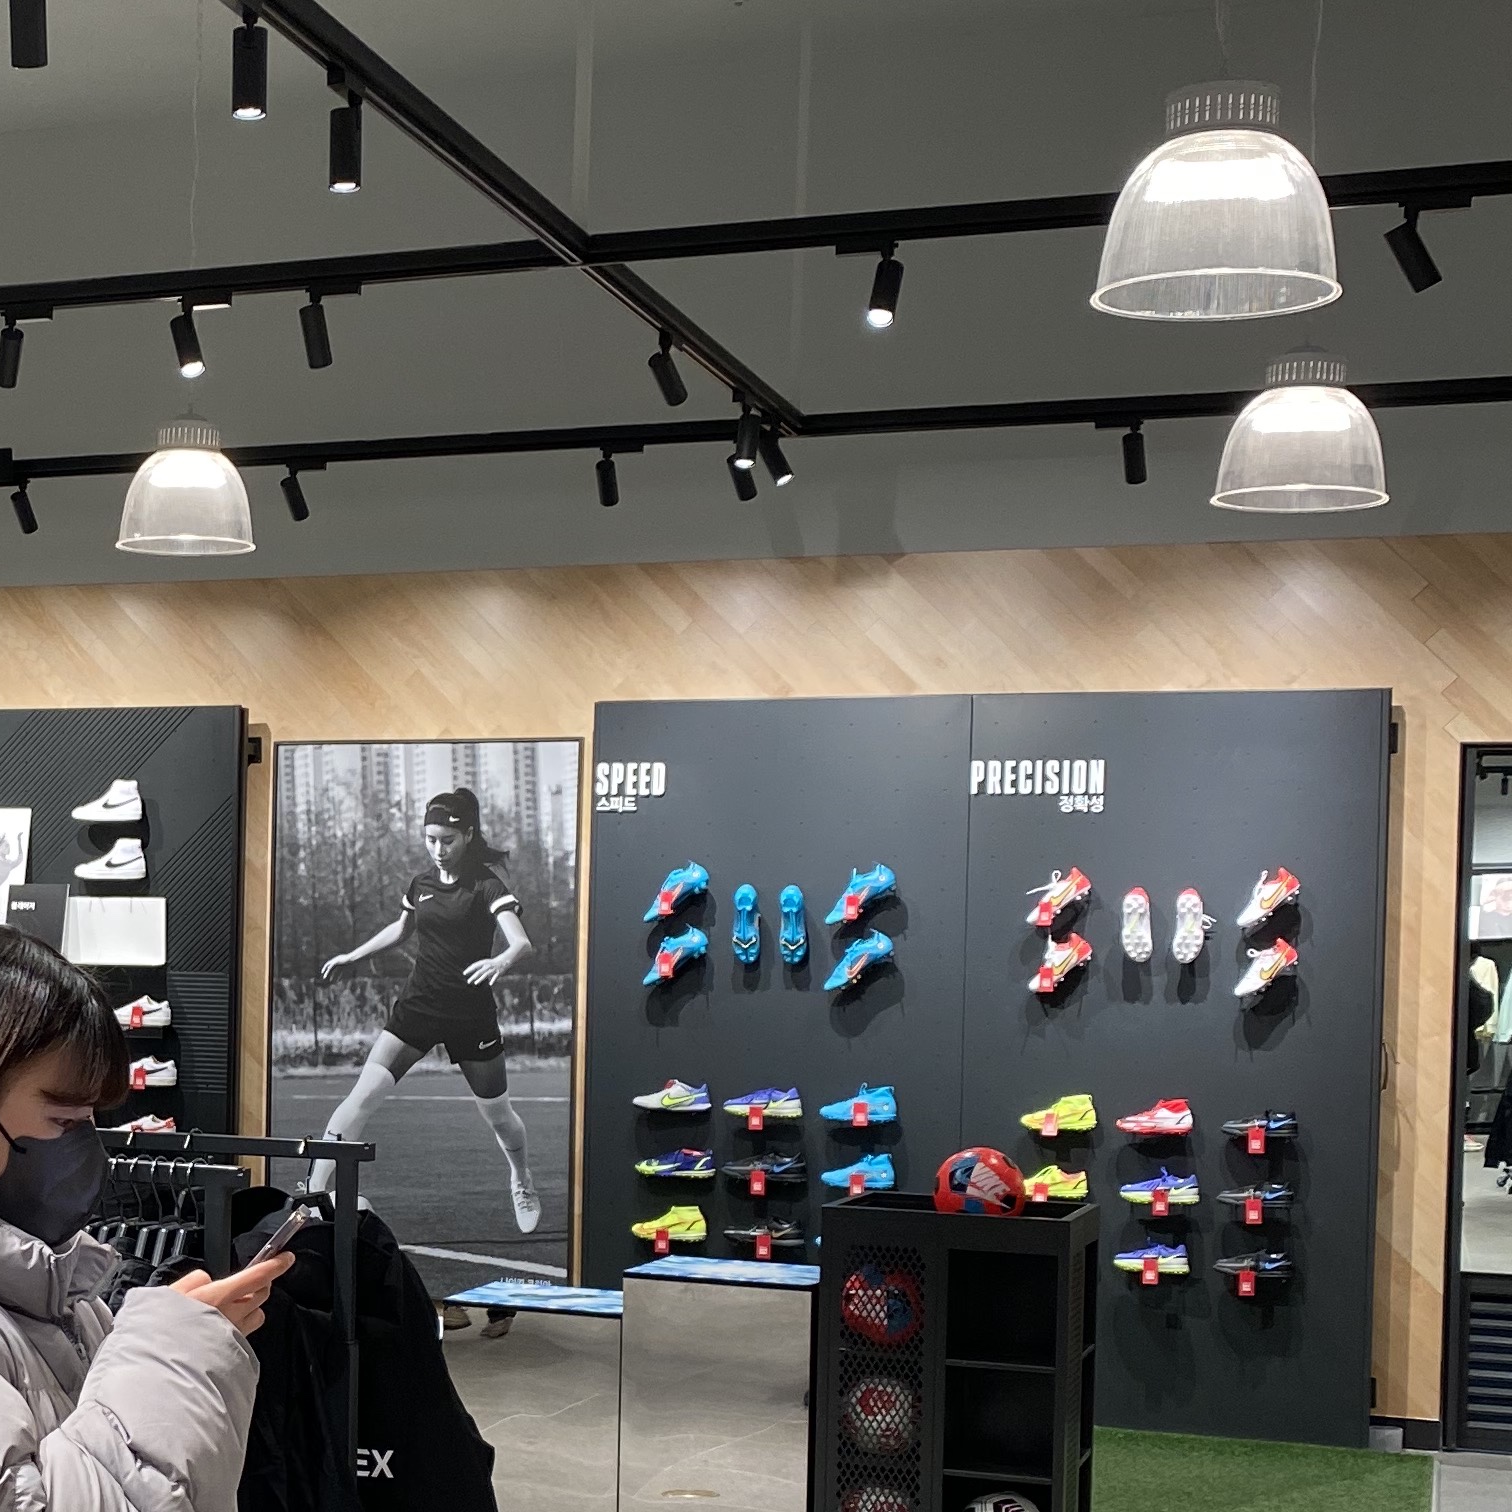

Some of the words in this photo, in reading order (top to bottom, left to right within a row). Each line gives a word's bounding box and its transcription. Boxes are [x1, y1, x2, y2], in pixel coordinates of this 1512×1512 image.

[595, 761, 666, 796] SPEED
[970, 759, 1105, 795] PRECISION
[595, 796, 638, 813] 스피드
[1059, 795, 1105, 813] 정확성
